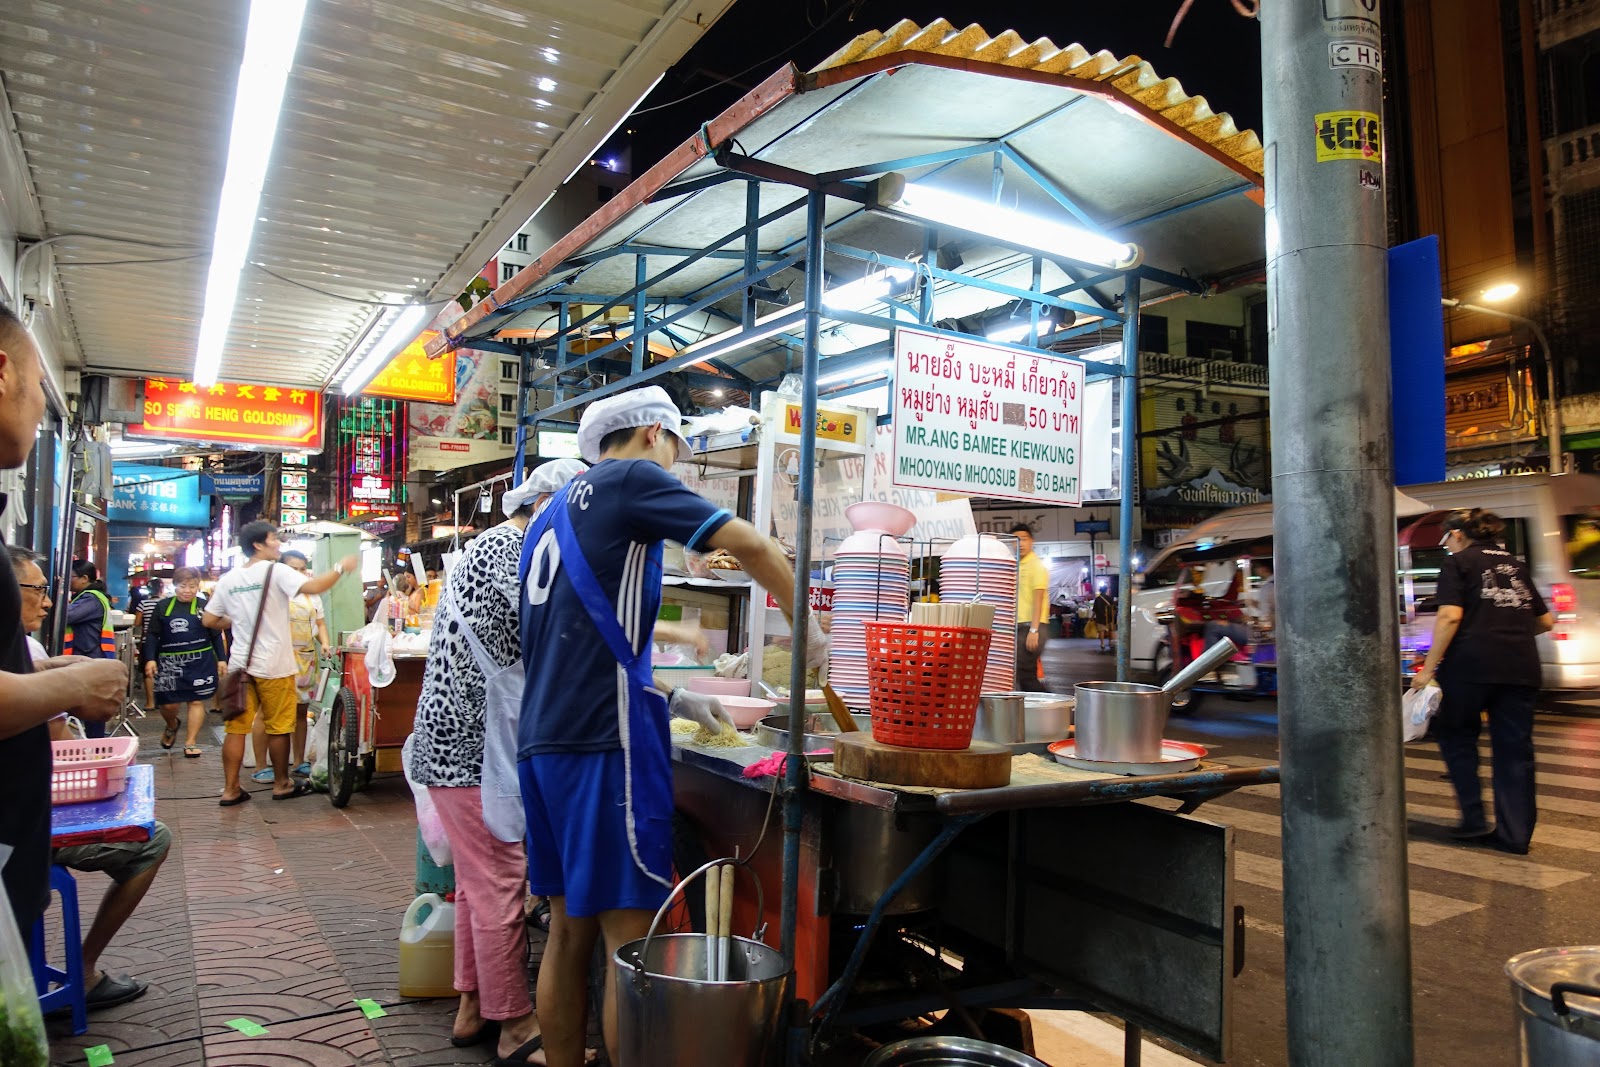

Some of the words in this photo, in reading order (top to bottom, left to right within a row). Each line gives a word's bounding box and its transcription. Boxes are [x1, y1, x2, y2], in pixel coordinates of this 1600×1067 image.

[391, 378, 448, 393] GOLDSMITH
[907, 344, 962, 381] นายอั๊ง
[970, 355, 1016, 390] บะหมี่
[1022, 359, 1077, 408] เกี๊ยวกุ้ง
[144, 402, 162, 415] SO
[205, 406, 239, 423] HENG
[243, 410, 309, 428] GOLDSMITH
[901, 384, 950, 422] หมูย่าง
[958, 391, 999, 430] หมูสับ
[1053, 411, 1078, 434] บาท
[906, 425, 959, 450] MR.ANG
[963, 433, 1007, 456] BAMEE
[1011, 440, 1074, 465] KIEWKUNG
[899, 456, 962, 482] MHOOYANG
[965, 467, 1016, 488] MHOOSUB
[1036, 475, 1050, 493] 50
[1052, 475, 1077, 494] BAHT
[108, 499, 137, 511] BANK
